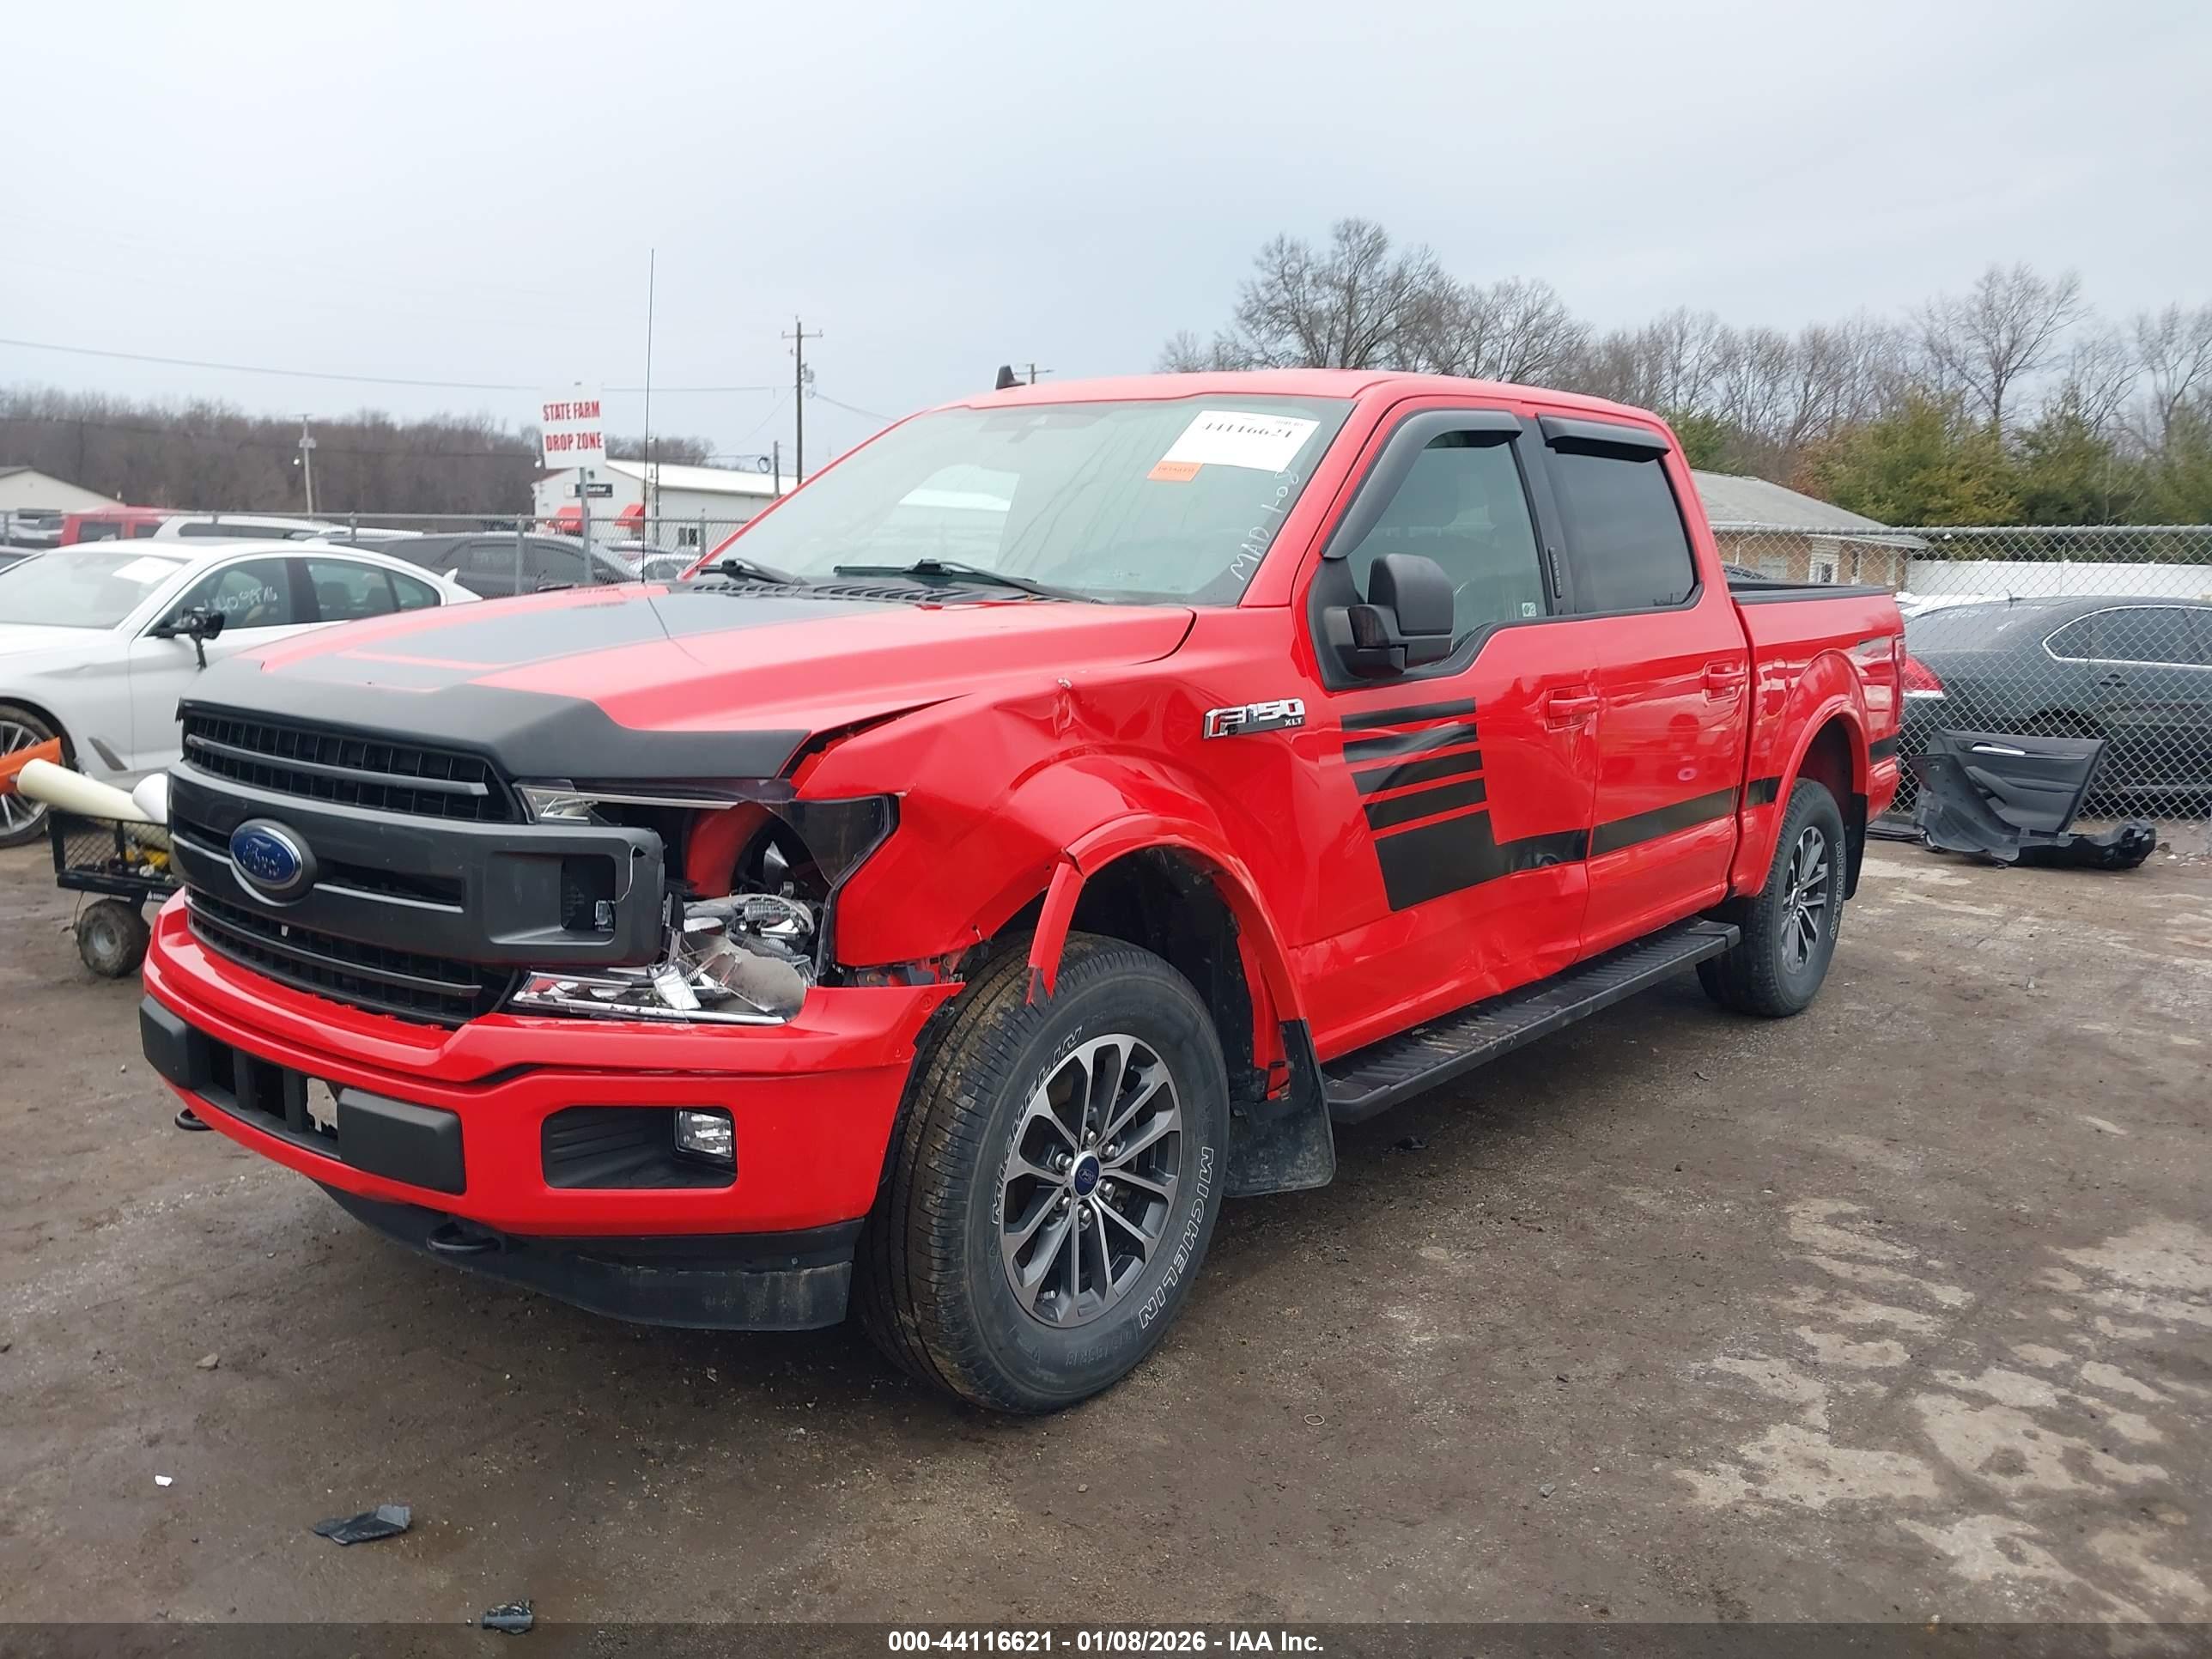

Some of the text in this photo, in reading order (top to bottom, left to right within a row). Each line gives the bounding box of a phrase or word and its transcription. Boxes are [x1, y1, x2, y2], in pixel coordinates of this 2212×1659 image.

[543, 400, 600, 422] STATE FARM
[545, 432, 603, 452] DROP ZONE
[1285, 716, 1304, 726] XLT
[242, 836, 282, 877] Ford
[1138, 1146, 1215, 1329] MICHELIN
